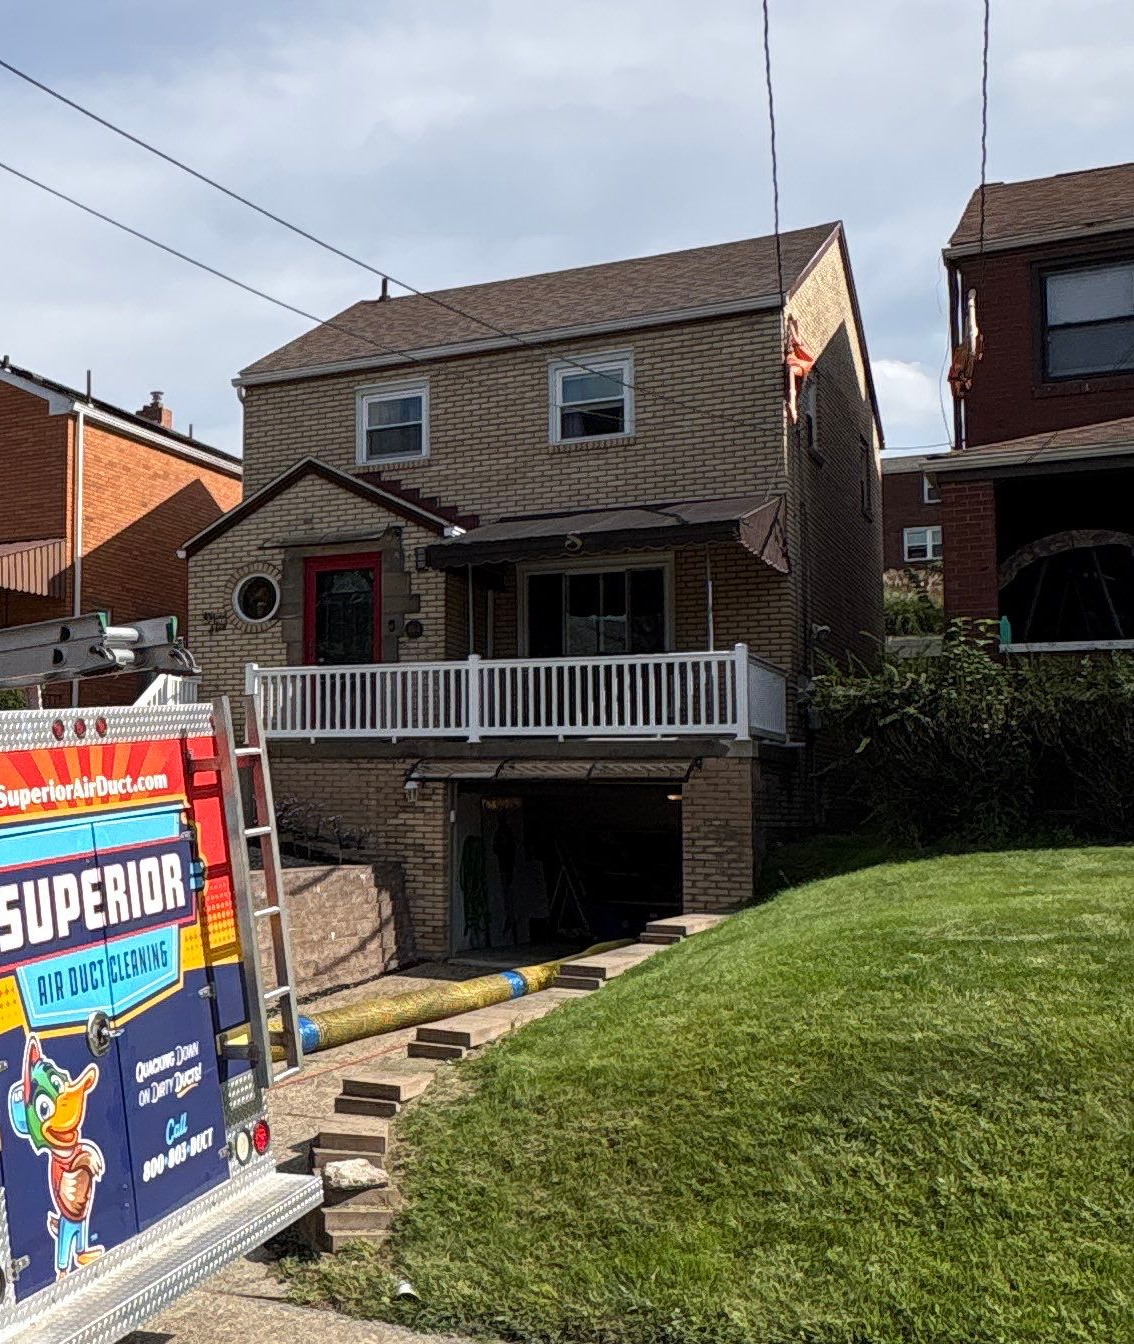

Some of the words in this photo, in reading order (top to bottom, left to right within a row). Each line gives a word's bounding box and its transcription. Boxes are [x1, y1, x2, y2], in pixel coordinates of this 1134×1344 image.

[37, 966, 65, 1007] AIR
[69, 958, 106, 996] DUCT
[109, 940, 169, 984] CLEANING
[165, 1112, 189, 1146] Call
